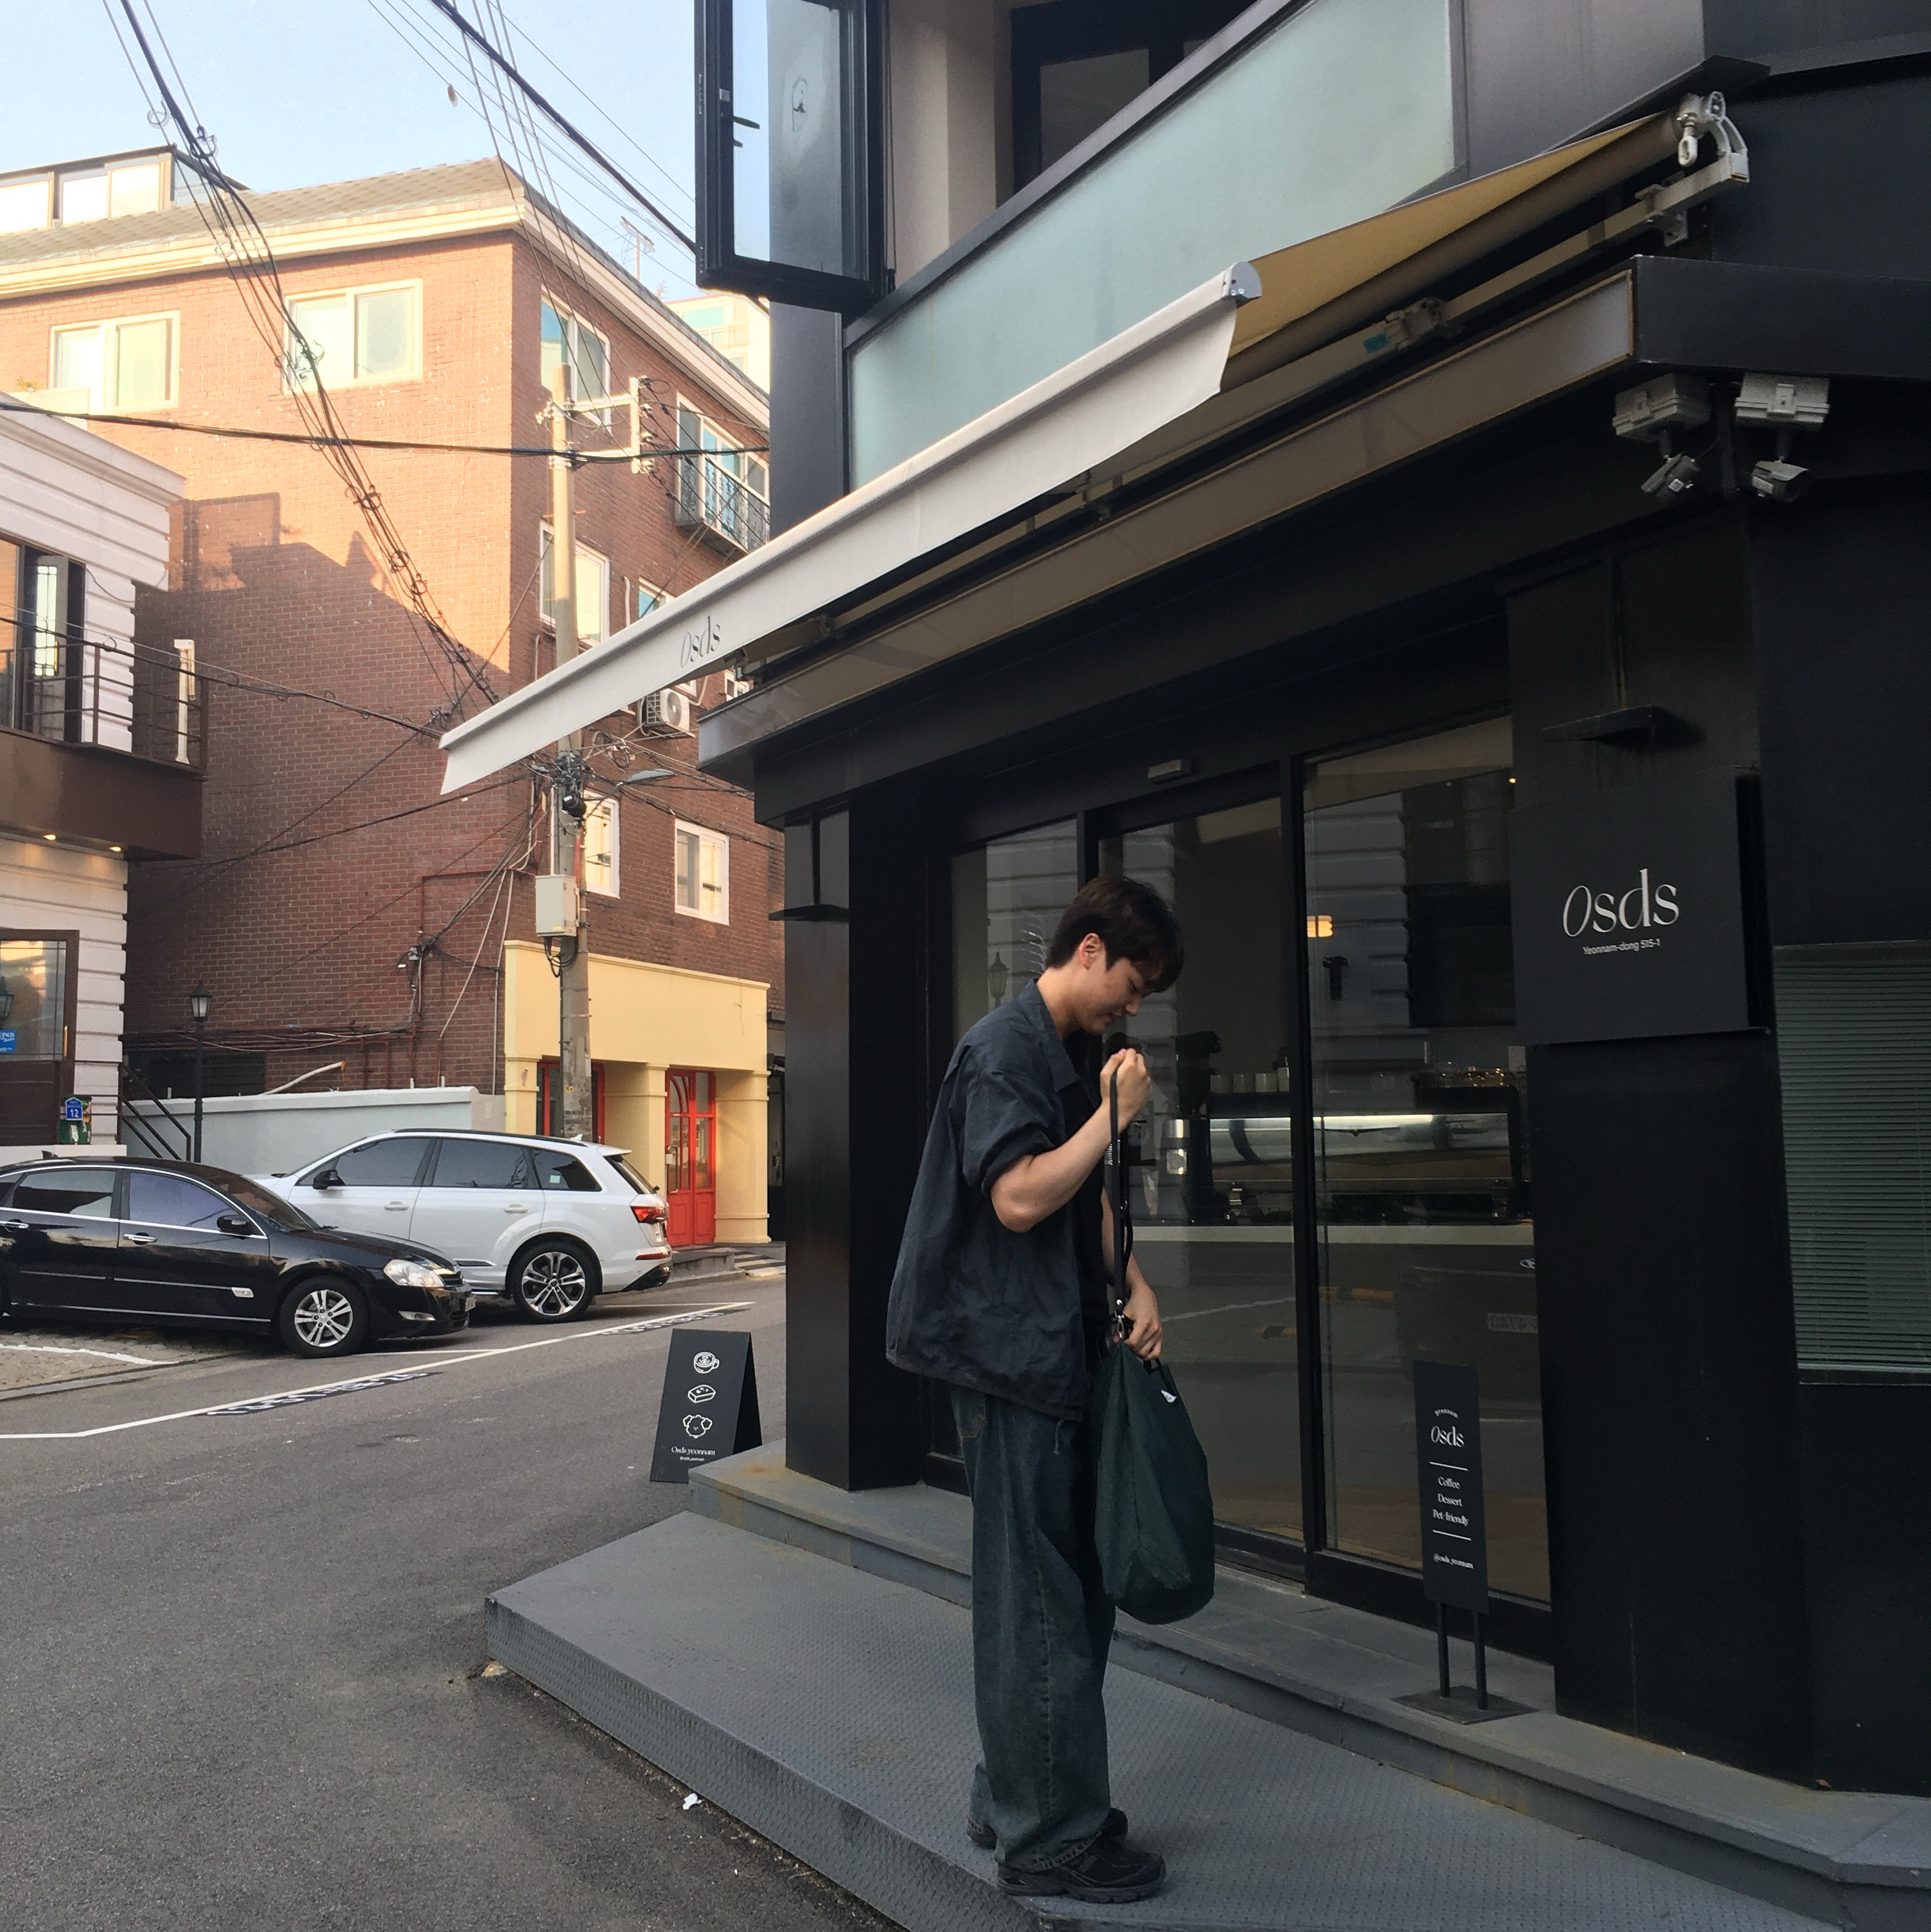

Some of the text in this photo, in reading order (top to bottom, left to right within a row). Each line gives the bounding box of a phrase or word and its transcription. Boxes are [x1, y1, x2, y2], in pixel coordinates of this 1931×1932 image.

[680, 615, 720, 668] Osds
[1562, 868, 1679, 937] Osds
[70, 1109, 79, 1118] 12
[1431, 1426, 1465, 1447] Osds
[1438, 1476, 1461, 1489] Coffee
[1437, 1493, 1463, 1507] Dessert
[1433, 1508, 1469, 1526] Pet-friendly
